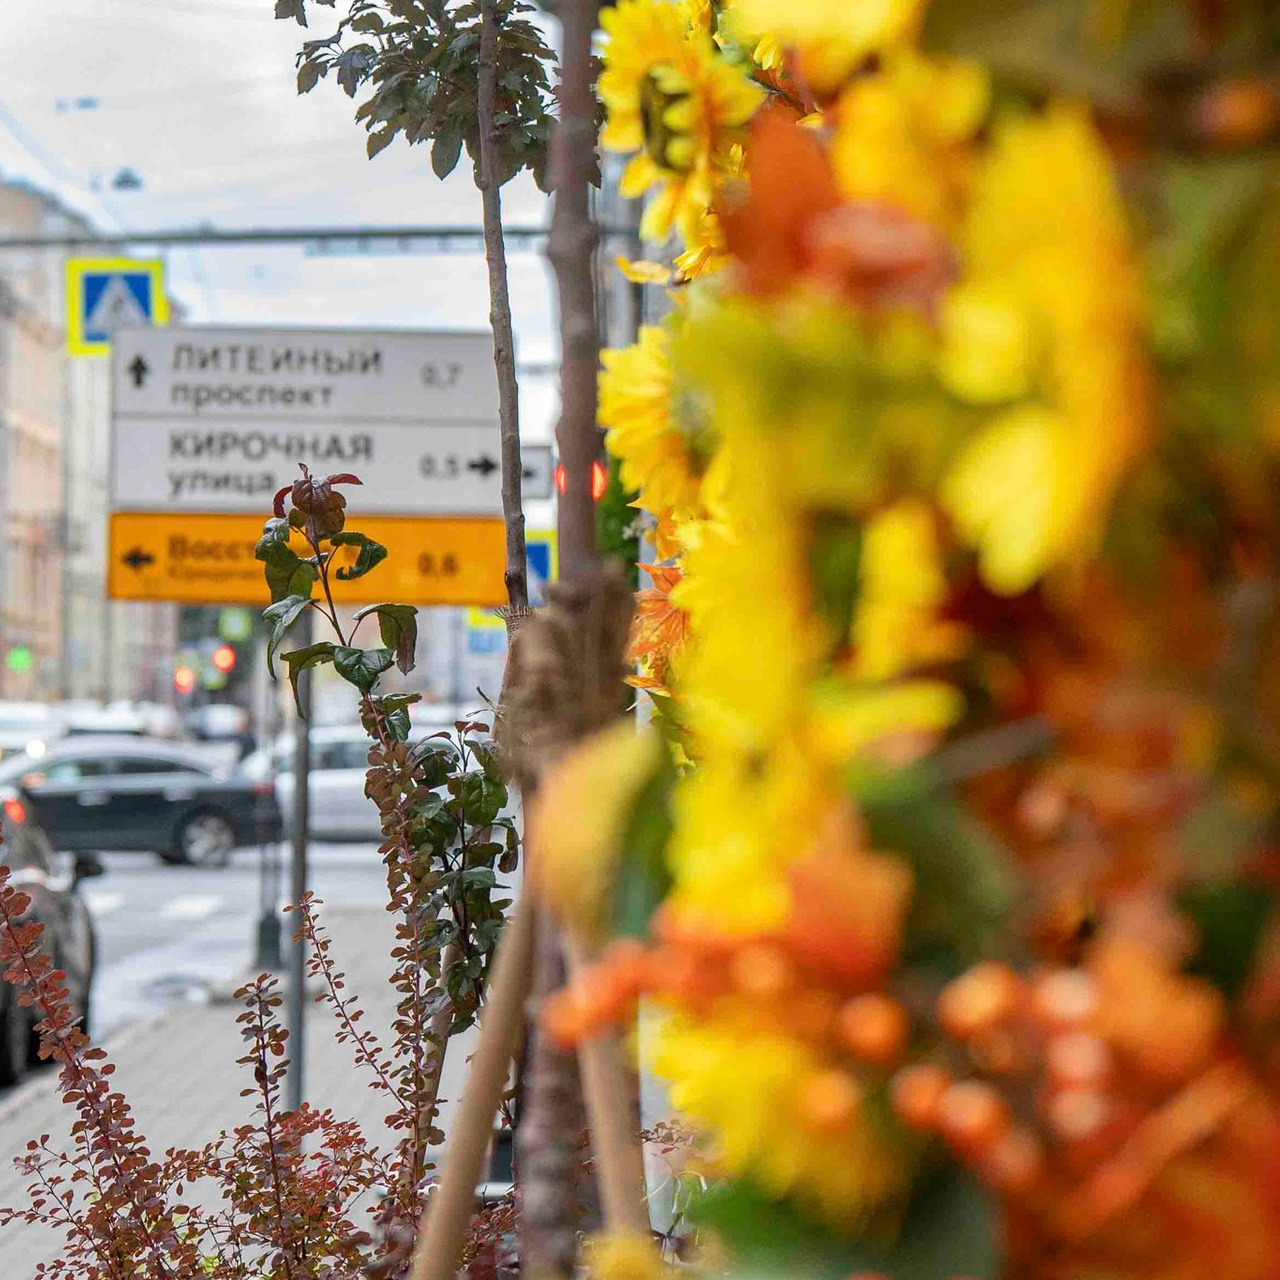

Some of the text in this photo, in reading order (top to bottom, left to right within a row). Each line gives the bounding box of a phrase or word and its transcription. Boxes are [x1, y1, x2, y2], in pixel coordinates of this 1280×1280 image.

[172, 385, 333, 412] проспект
[170, 431, 374, 461] КИРОЧНАЯ
[169, 472, 275, 499] улица
